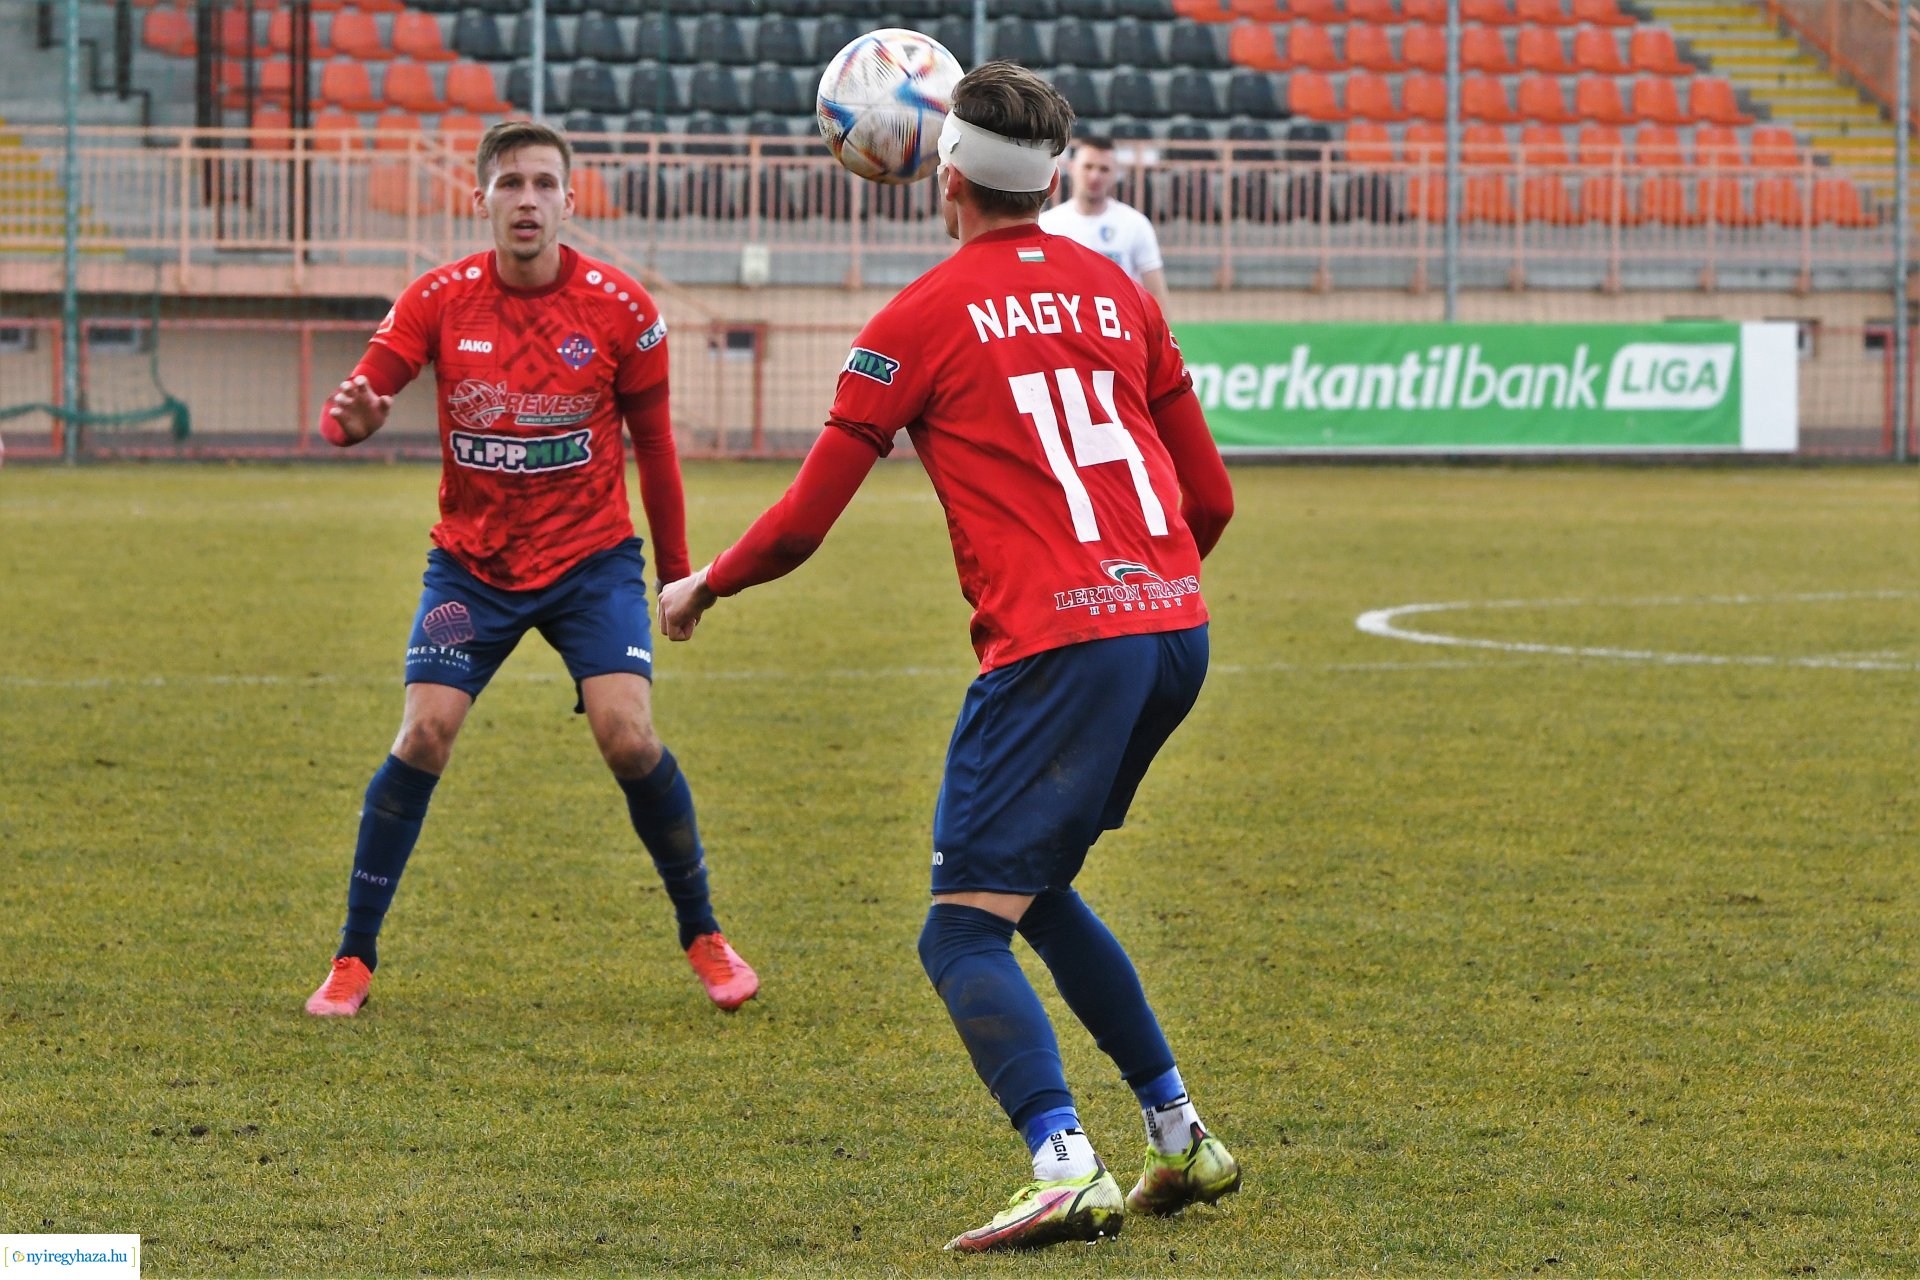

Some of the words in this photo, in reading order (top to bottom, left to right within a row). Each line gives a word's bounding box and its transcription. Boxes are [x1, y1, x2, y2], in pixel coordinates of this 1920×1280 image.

[967, 292, 1082, 343] NAGY
[1094, 296, 1131, 340] B.
[457, 338, 493, 353] JAKO
[1621, 358, 1719, 394] LIGA
[1008, 368, 1168, 542] 14
[1054, 584, 1141, 610] LERTON
[1143, 576, 1200, 600] TRANS
[1090, 598, 1182, 615] HUNGARY
[407, 646, 472, 662] PRESTIGE
[354, 869, 389, 887] JAKO
